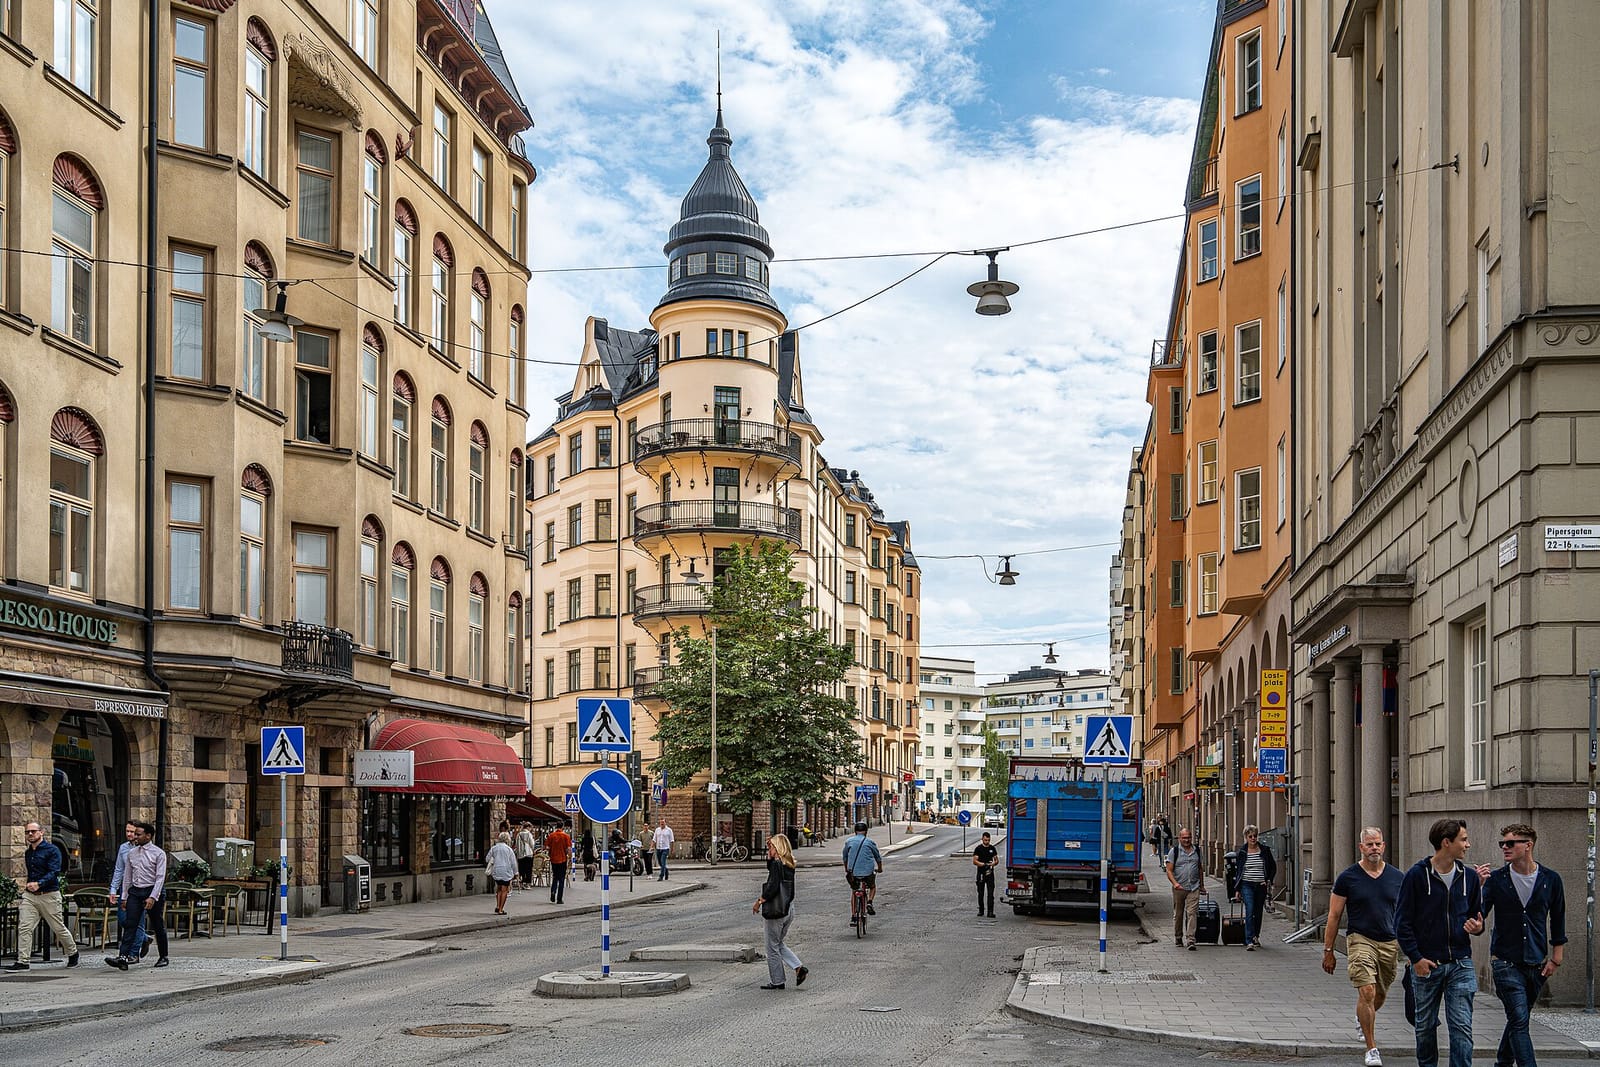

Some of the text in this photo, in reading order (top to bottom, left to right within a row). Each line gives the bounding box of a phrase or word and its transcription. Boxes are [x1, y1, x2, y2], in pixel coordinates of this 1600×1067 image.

[1547, 528, 1592, 536] Pipersgatan
[1547, 541, 1572, 549] 22-16
[57, 610, 119, 643] HOUSE
[94, 700, 164, 718] ESPRESSO HOUSE
[360, 771, 407, 781] Dolc Vita
